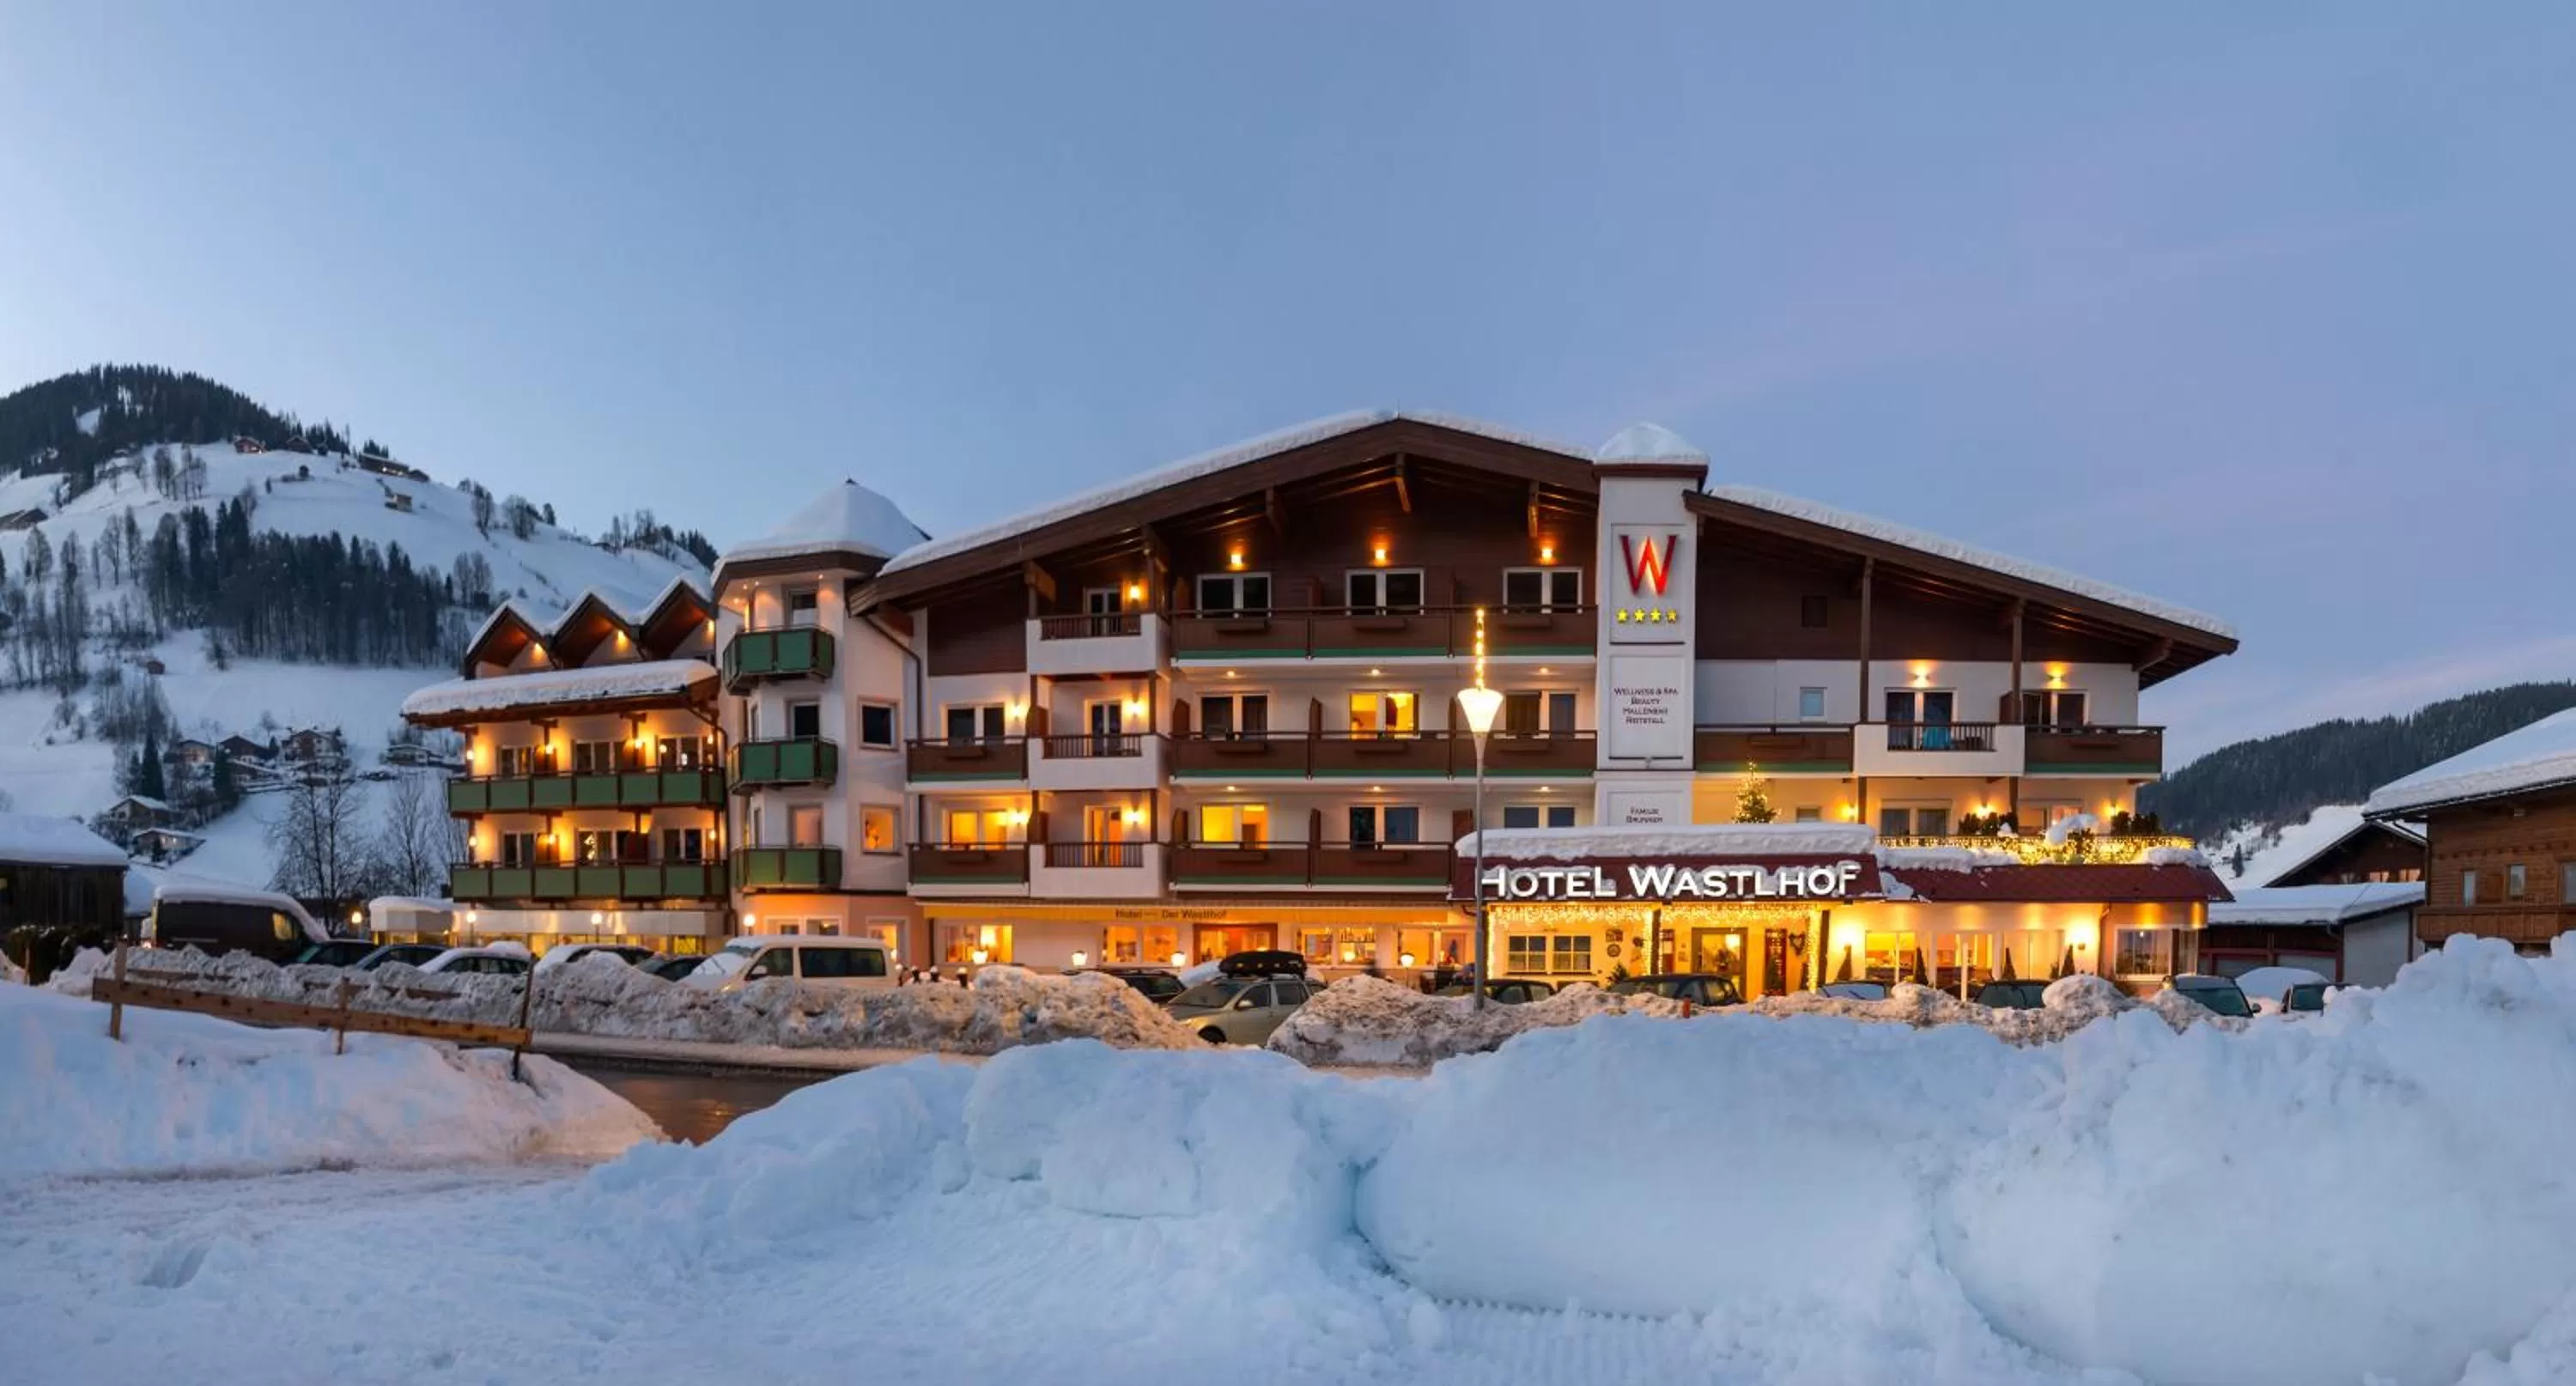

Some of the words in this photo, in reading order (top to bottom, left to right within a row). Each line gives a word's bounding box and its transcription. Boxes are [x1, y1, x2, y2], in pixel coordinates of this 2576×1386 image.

[1619, 534, 1677, 596] W
[1475, 866, 1617, 897] HOTEL
[1627, 864, 1862, 897] WASTLHOF
